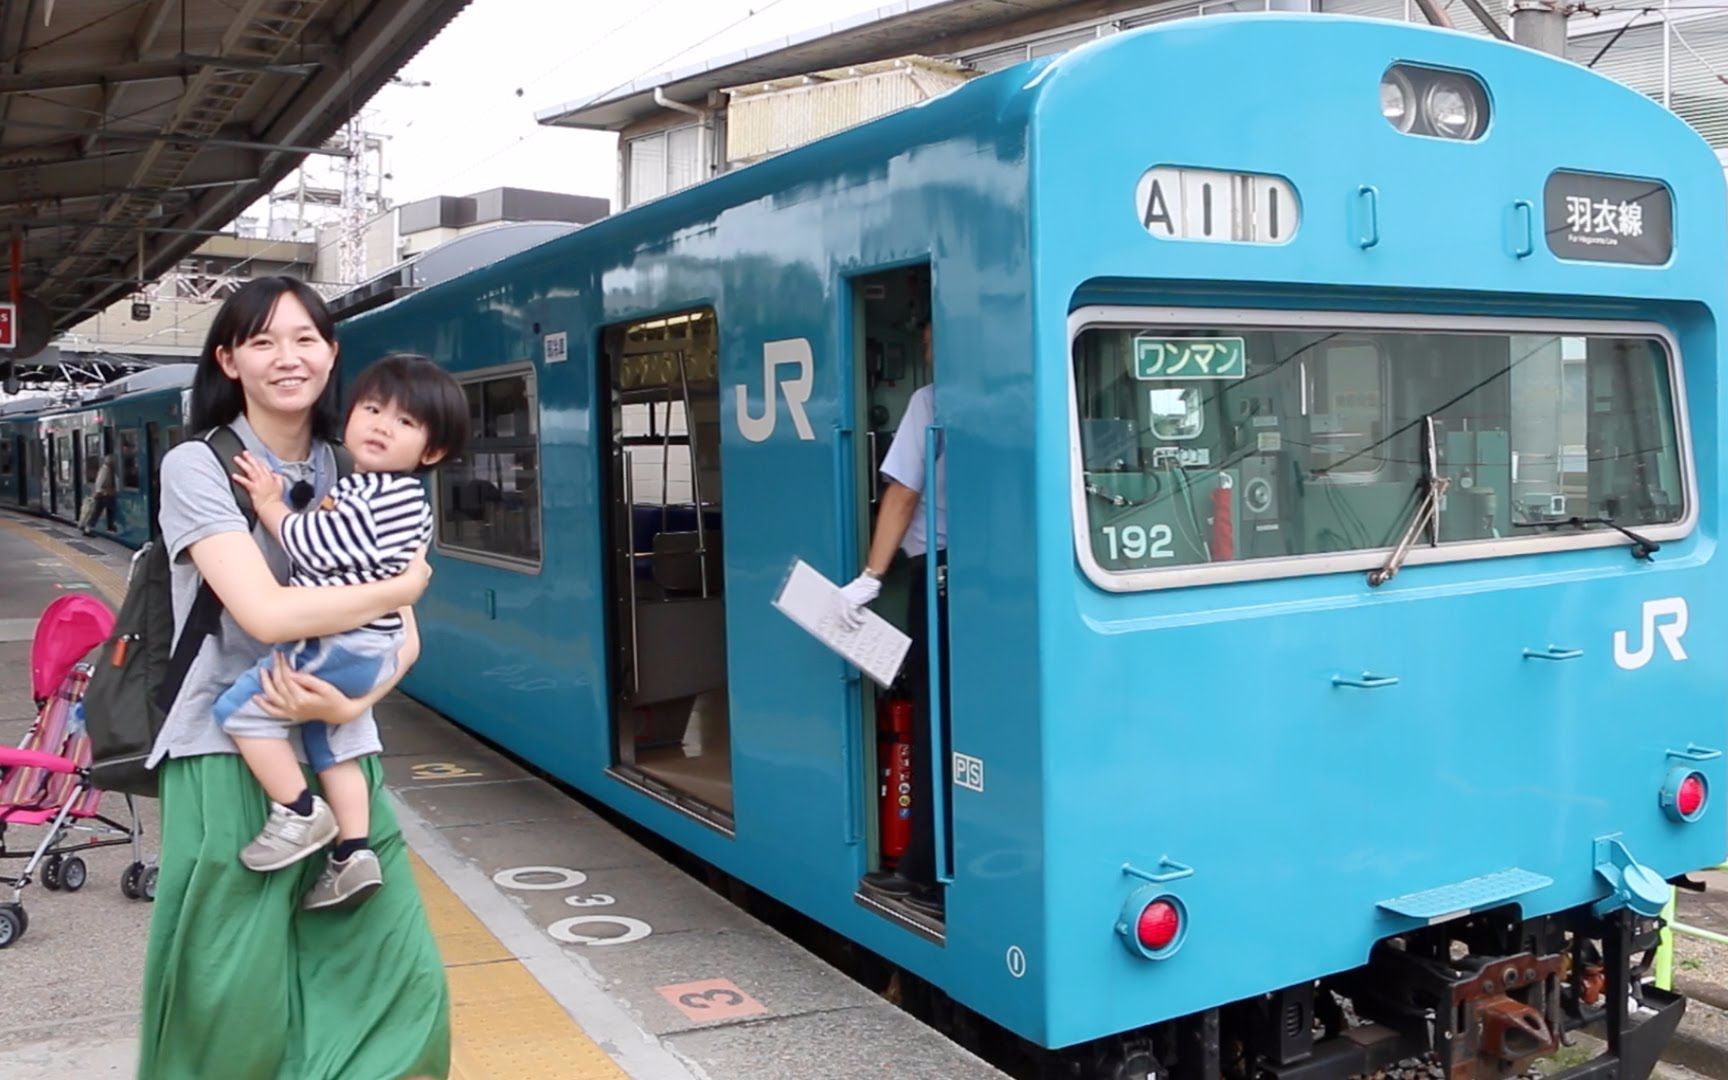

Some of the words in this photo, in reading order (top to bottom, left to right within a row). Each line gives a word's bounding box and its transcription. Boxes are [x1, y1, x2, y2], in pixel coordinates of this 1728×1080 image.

[1565, 196, 1643, 237] 羽衣線
[1139, 342, 1238, 374] ワンマン
[735, 337, 816, 442] JR
[1102, 524, 1174, 560] 192
[1614, 596, 1689, 670] JR
[679, 988, 744, 1009] 3
